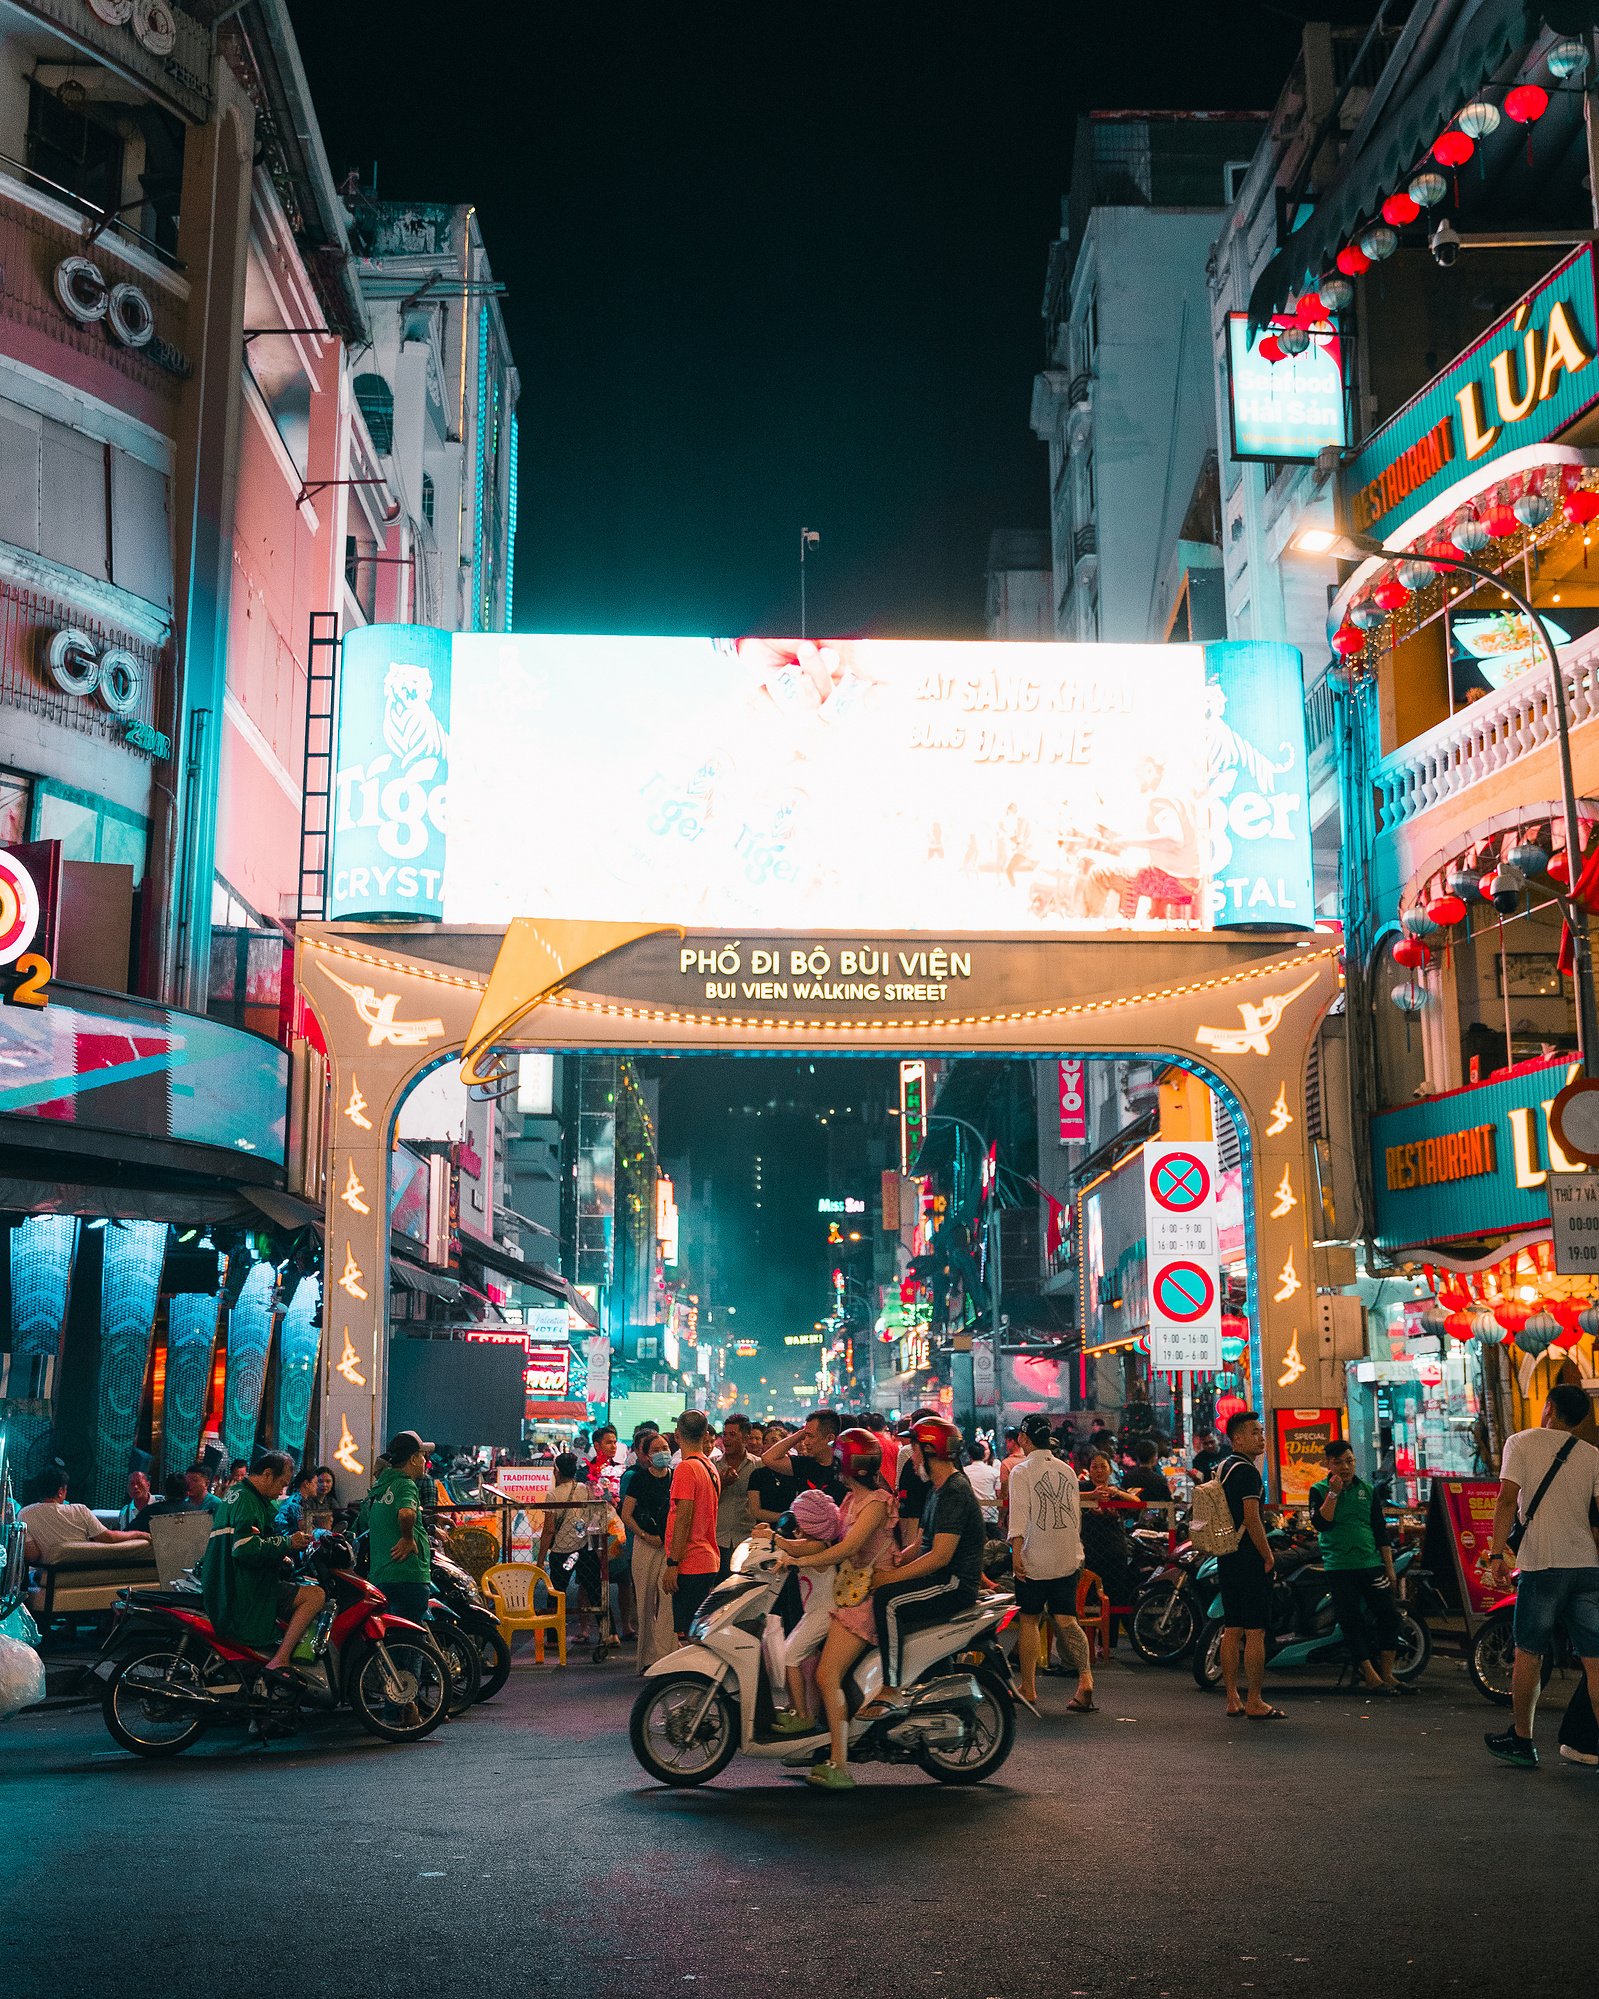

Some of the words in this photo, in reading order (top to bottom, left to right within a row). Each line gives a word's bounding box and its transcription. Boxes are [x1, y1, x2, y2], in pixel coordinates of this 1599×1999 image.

[55, 256, 154, 347] GO
[1455, 301, 1592, 460] LÚA
[1351, 416, 1455, 534] RESTAURANT
[50, 628, 142, 714] GO
[334, 865, 446, 902] CRYST
[680, 941, 741, 976] PHỐ
[751, 950, 780, 975] ĐI
[790, 945, 831, 980] BỘ
[840, 945, 889, 976] BÙI
[899, 947, 972, 981] VIỆN
[13, 953, 51, 1005] 2
[705, 982, 736, 1000] BUI
[742, 982, 788, 1000] VIEN
[793, 983, 880, 1001] WALKING
[884, 984, 948, 1001] STREET
[1386, 1124, 1496, 1191] RESTAURANT
[1555, 1184, 1572, 1202] THỨ
[1576, 1188, 1581, 1201] 7
[1161, 1224, 1177, 1234] 6:00
[1186, 1224, 1202, 1234] 9:00
[1569, 1217, 1599, 1231] 00:00
[1158, 1240, 1177, 1250] 16:00
[1186, 1240, 1206, 1250] 19:00
[1569, 1246, 1597, 1260] 19:00
[1163, 1334, 1179, 1344] 9:00
[1188, 1334, 1208, 1344] 16:00
[1163, 1351, 1183, 1360] 19:00
[1192, 1351, 1208, 1360] 6:00
